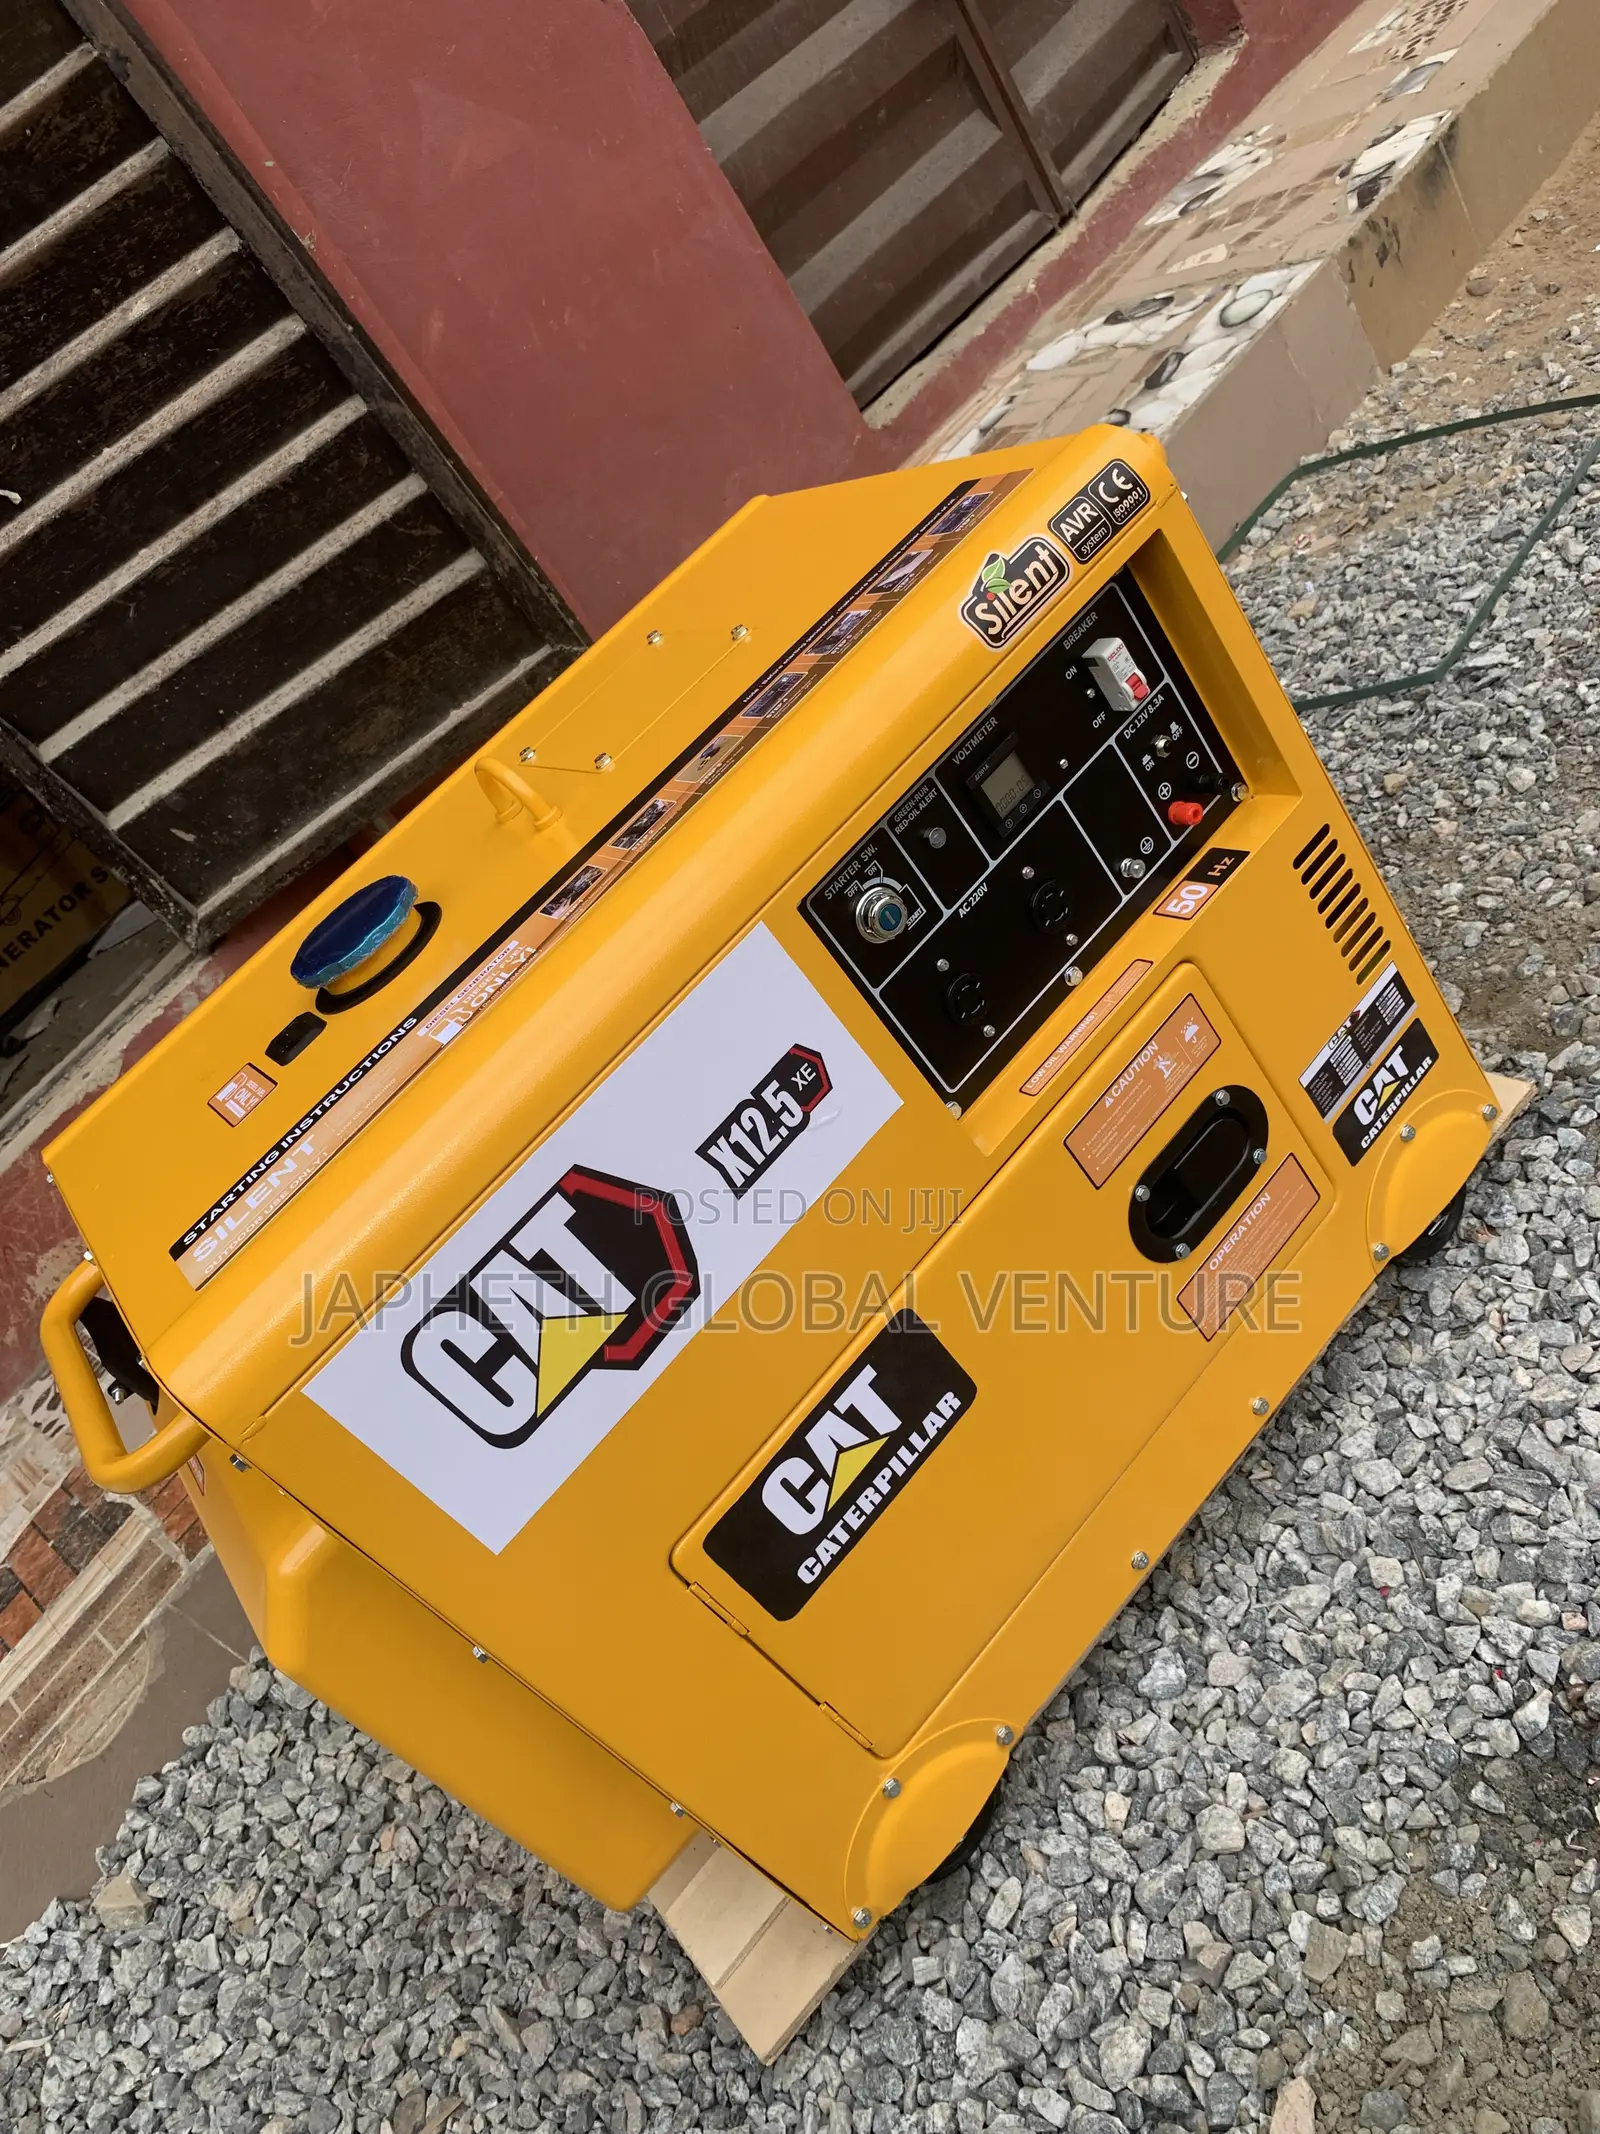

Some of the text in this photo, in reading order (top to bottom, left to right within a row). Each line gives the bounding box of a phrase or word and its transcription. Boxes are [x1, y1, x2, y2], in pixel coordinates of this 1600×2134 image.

[1059, 502, 1098, 542] AVR
[1112, 487, 1143, 517] ISO9001
[1081, 527, 1107, 555] system
[975, 545, 1058, 635] Silent
[1062, 611, 1099, 650] BREAKER
[1065, 665, 1077, 680] ON
[952, 716, 999, 765] VOLTMETER
[1092, 711, 1107, 729] OFF
[1123, 694, 1165, 739] DC 12V 8.3A
[1172, 726, 1183, 741] OFF
[1145, 759, 1155, 772] ON
[894, 785, 929, 823] GREEN-RUN
[895, 788, 938, 835] RED-OIL ALERT
[824, 845, 878, 900] STARTER SW.
[847, 884, 859, 898] OFF
[867, 865, 878, 877] ON
[1165, 856, 1235, 914] 50 Hz
[906, 909, 923, 927] START
[958, 882, 989, 918] AC 220V
[425, 947, 511, 1029] DIESEL GENERATOR
[471, 947, 536, 1007] ONLY!
[1025, 1010, 1098, 1090] LOW OIL WARNING!
[1328, 1015, 1352, 1050] CAT
[1111, 1040, 1159, 1098] CAUTION
[1353, 1045, 1409, 1126] CAT
[707, 1063, 816, 1189] X12.5 XE
[1361, 1056, 1433, 1149] CATERPILLAR
[183, 1150, 279, 1246] STARTING
[281, 1017, 417, 1148] INSTRUCTIONS
[192, 1134, 315, 1263] SILENT
[204, 1213, 264, 1274] OUTDOOR
[265, 1189, 289, 1215] USE
[1209, 1192, 1271, 1271] OPERATION
[408, 1191, 638, 1438] CAT
[761, 1364, 902, 1536] CAT
[797, 1391, 962, 1585] CATERPILLAR
